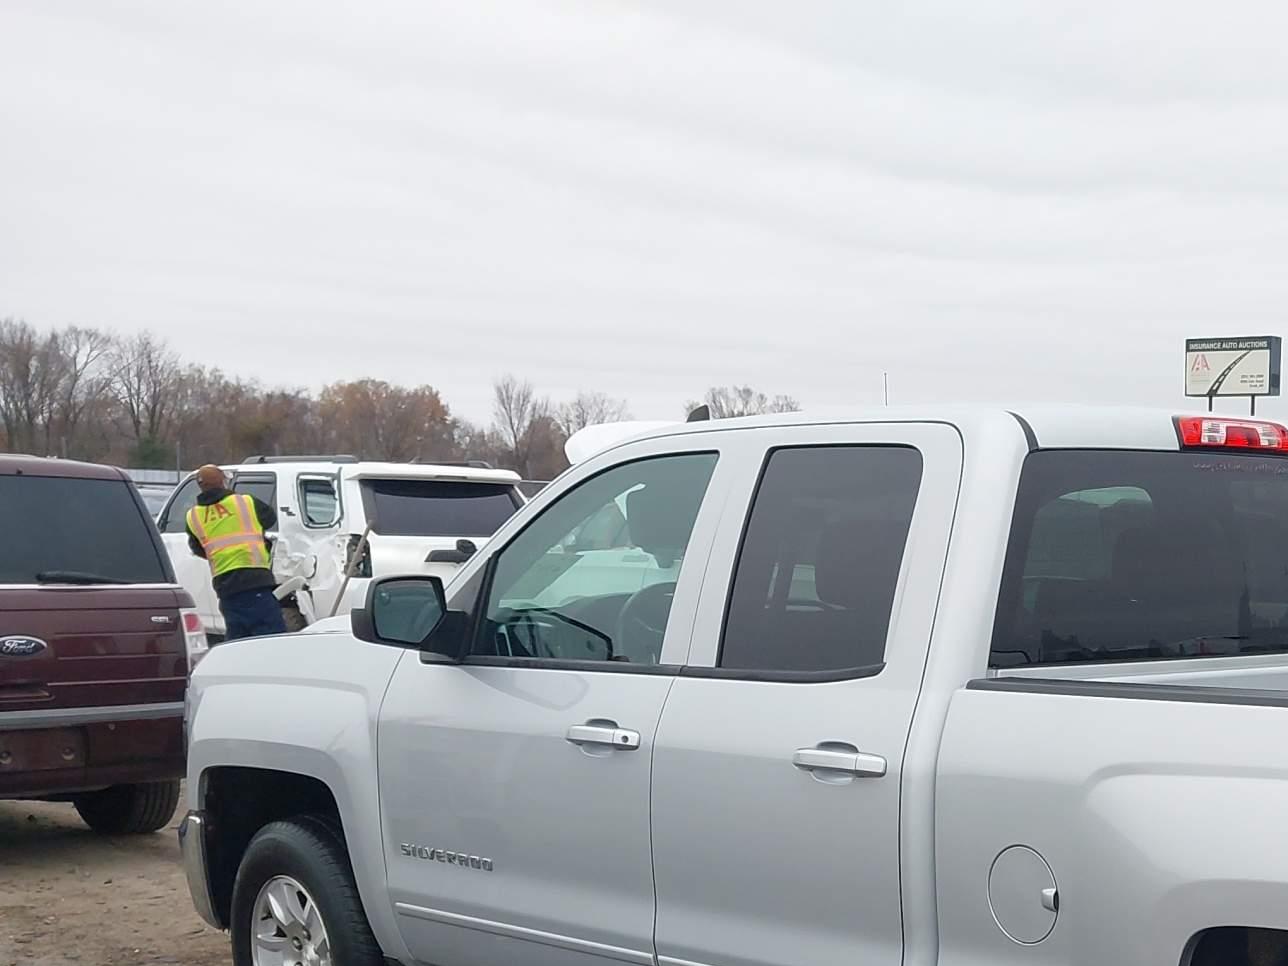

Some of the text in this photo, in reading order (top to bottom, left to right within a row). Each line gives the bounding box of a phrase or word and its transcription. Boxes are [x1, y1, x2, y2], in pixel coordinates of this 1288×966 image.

[1189, 342, 1221, 350] INSURANCE
[1238, 340, 1268, 349] AUCTIONS
[2, 639, 35, 653] Ford
[400, 842, 494, 872] SILVERADO
